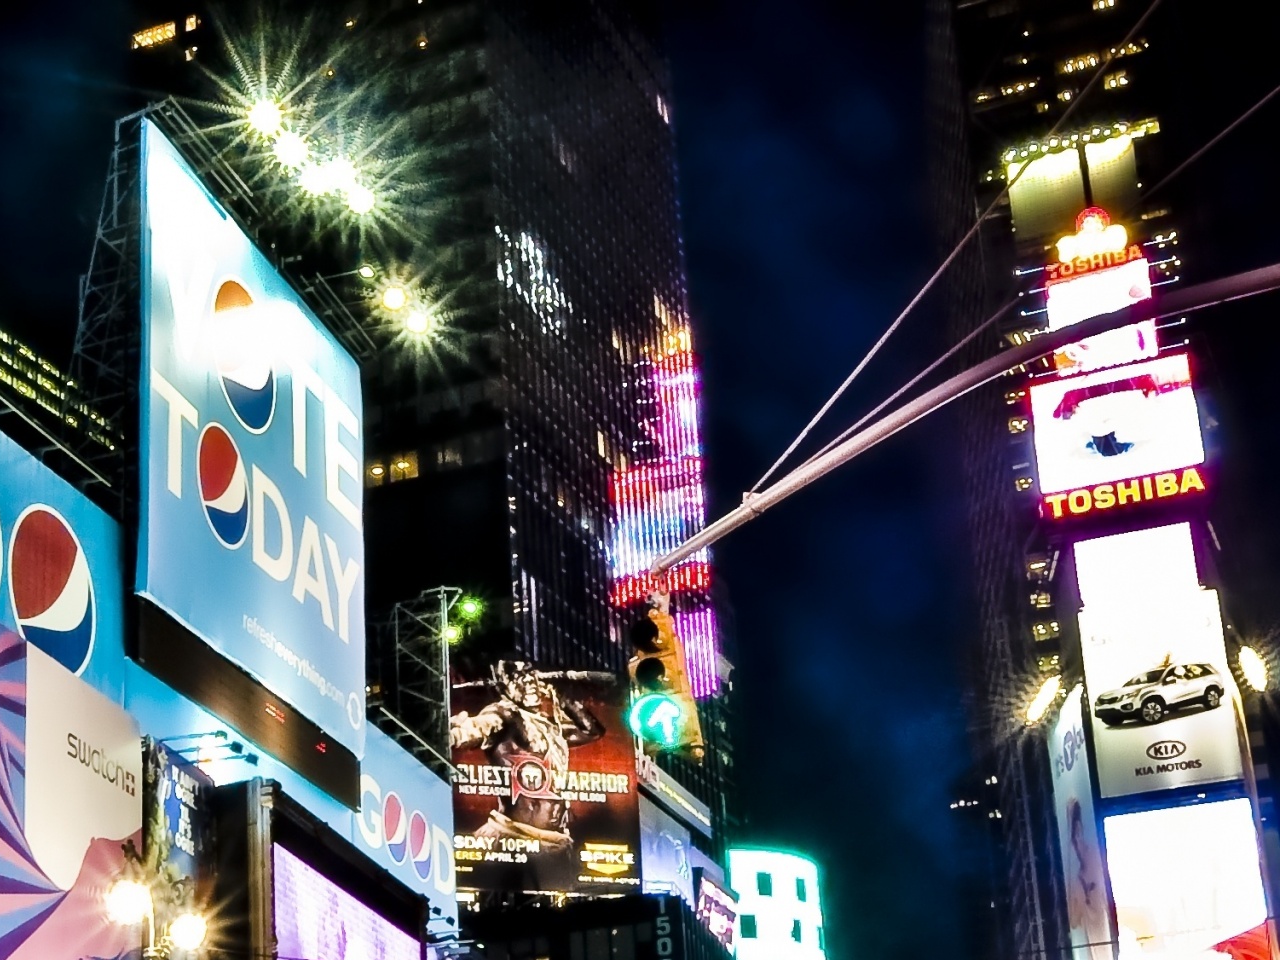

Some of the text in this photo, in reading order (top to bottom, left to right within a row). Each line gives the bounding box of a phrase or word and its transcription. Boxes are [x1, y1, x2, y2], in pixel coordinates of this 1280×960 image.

[1046, 467, 1207, 519] TOSHIBA
[151, 368, 361, 644] TODAY
[242, 614, 346, 708] refresheverything.com
[1153, 743, 1180, 757] KIA
[67, 732, 127, 792] swatch
[1135, 759, 1203, 777] KIA MOTORS
[552, 770, 629, 794] WARRIOR
[458, 784, 511, 797] NEW SEASON
[579, 791, 607, 803] BLOOD
[500, 838, 541, 853] 10PM
[484, 852, 514, 864] APRIL
[515, 853, 528, 864] 20
[580, 850, 635, 865] SPIKE
